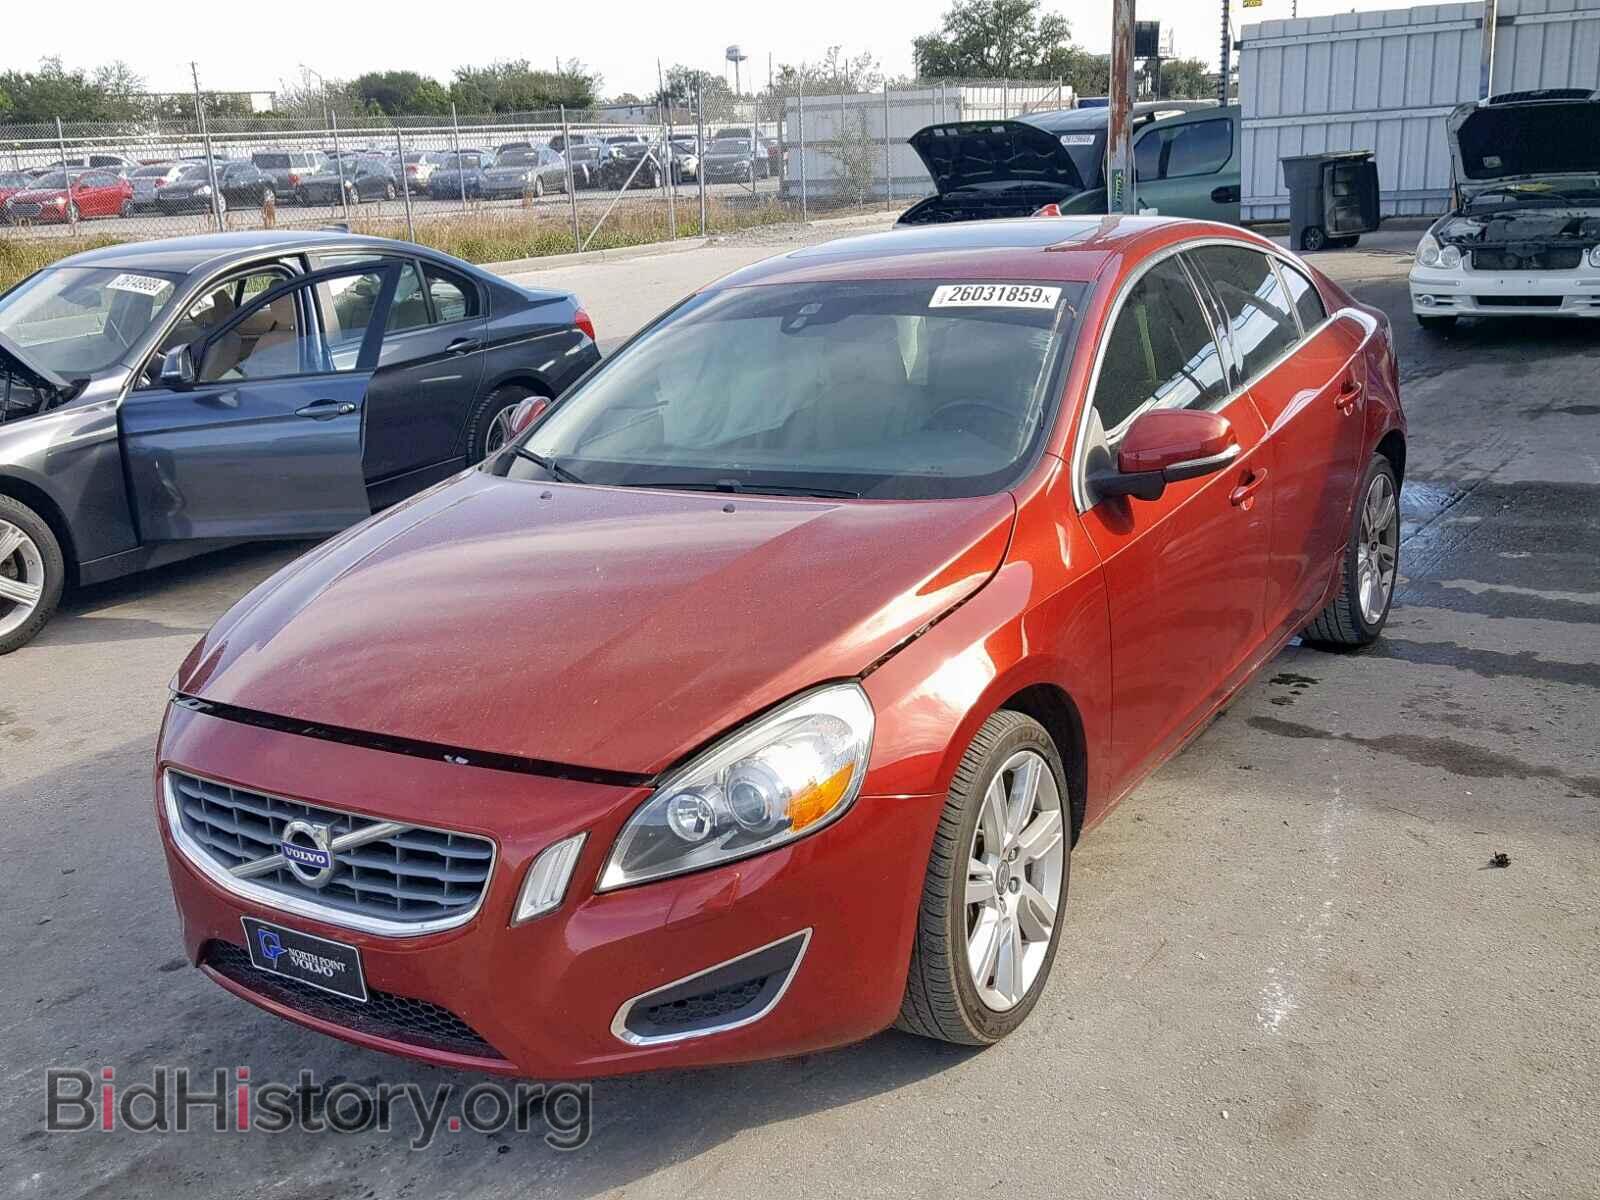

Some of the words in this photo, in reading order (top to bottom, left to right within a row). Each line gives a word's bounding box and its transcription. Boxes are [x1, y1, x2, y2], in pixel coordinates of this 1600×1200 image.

[284, 846, 326, 864] VOLVO
[288, 947, 318, 964] NORTH
[319, 956, 346, 972] POINT
[290, 956, 334, 977] VOLVO
